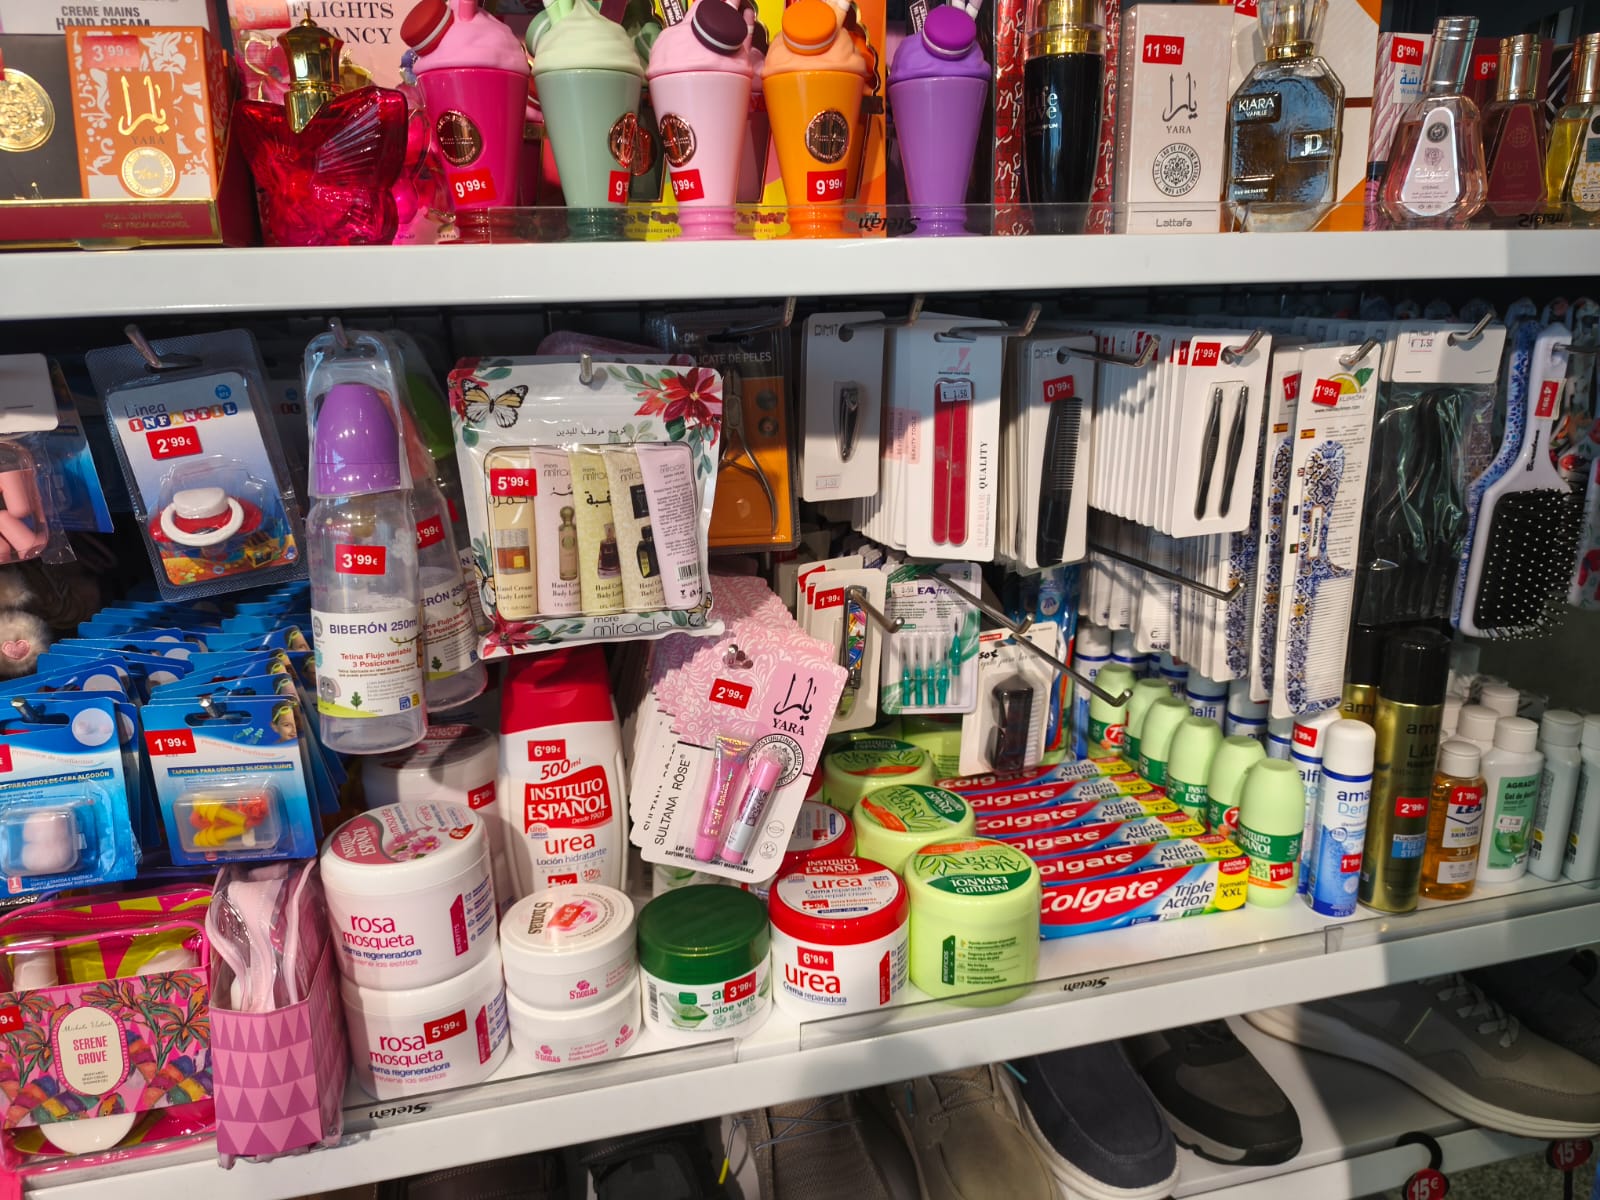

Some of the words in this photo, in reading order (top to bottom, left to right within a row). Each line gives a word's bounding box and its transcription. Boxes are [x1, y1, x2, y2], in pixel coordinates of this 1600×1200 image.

[61, 6, 100, 17] CREME
[103, 6, 140, 17] MAINS
[1145, 43, 1181, 58] 11'99€
[1239, 98, 1275, 111] KIARA
[1166, 126, 1192, 134] YARA
[455, 179, 487, 198] 9'99€
[815, 179, 843, 195] 9'99€
[1156, 217, 1193, 228] Lattafa
[743, 351, 772, 363] PELES
[1193, 347, 1217, 362] 1'99€
[1047, 382, 1071, 397] 0'99€
[1316, 385, 1337, 398] 1'99€
[128, 402, 239, 432] INFANTIL
[156, 436, 192, 453] 2'99€
[978, 441, 988, 490] QUALITY
[498, 476, 530, 490] 5'99€
[342, 552, 378, 568] 3'99€
[593, 615, 620, 624] more
[329, 621, 387, 635] BIBERÓN
[593, 619, 674, 638] miracle
[340, 652, 363, 661] Tetina
[365, 651, 385, 661] Flujo
[359, 658, 402, 668] Posiciones.
[716, 686, 744, 701] 2'99€
[772, 718, 805, 736] YARA
[155, 738, 187, 751] 1'99€
[533, 745, 561, 757] 6'99€
[1298, 768, 1321, 783] alfi
[8, 780, 26, 789] PARA
[529, 777, 604, 801] INSTITUTO
[968, 788, 1055, 807] olgate
[1081, 781, 1115, 794] Triple
[1078, 786, 1118, 799] Action
[527, 793, 609, 821] ESPAÑOL
[1100, 806, 1142, 820] Action
[1102, 800, 1137, 813] Triple
[1455, 805, 1482, 815] LEA
[571, 815, 589, 825] Desde
[655, 796, 680, 846] SULTANA
[1013, 830, 1100, 852] olgate
[1127, 820, 1163, 833] Triple
[1125, 828, 1168, 841] Action
[545, 833, 596, 855] urea
[536, 856, 564, 866] Loción
[564, 847, 608, 863] hidratante
[807, 857, 857, 867] INSTITUTO
[1039, 852, 1133, 879] olgate
[1161, 841, 1199, 854] Triple
[1157, 849, 1203, 862] Action
[805, 863, 860, 874] ESPAÑOL
[1222, 859, 1247, 868] AHORA
[812, 877, 863, 889] urea
[951, 875, 1008, 889] ESPAÑOL
[956, 884, 1009, 894] INSTITUTO
[1219, 880, 1248, 888] Formato
[1040, 878, 1160, 913] Colgate
[1175, 879, 1215, 898] Triple
[1162, 891, 1210, 910] Action
[1221, 888, 1242, 898] XXL
[350, 914, 396, 933] rosa
[342, 931, 415, 951] mosqueta
[363, 948, 423, 960] regeneradora
[802, 950, 829, 966] 6'99€
[784, 963, 841, 995] urea
[569, 986, 599, 1000] S'nonas
[782, 981, 804, 999] Crema
[804, 991, 848, 1004] reparadora
[711, 1003, 735, 1016] aloe
[736, 994, 756, 1008] vera
[431, 1020, 461, 1039] 5'99€
[72, 1035, 109, 1052] SERENE
[379, 1033, 426, 1052] rosa
[77, 1051, 108, 1066] GROVE
[369, 1048, 444, 1068] mosqueta
[535, 1051, 561, 1064] S'nonas
[391, 1061, 451, 1077] regeneradora
[404, 1076, 417, 1084] las
[368, 1102, 430, 1119] Stelan
[1557, 1139, 1585, 1163] 15€
[1412, 1177, 1440, 1200] 15€
